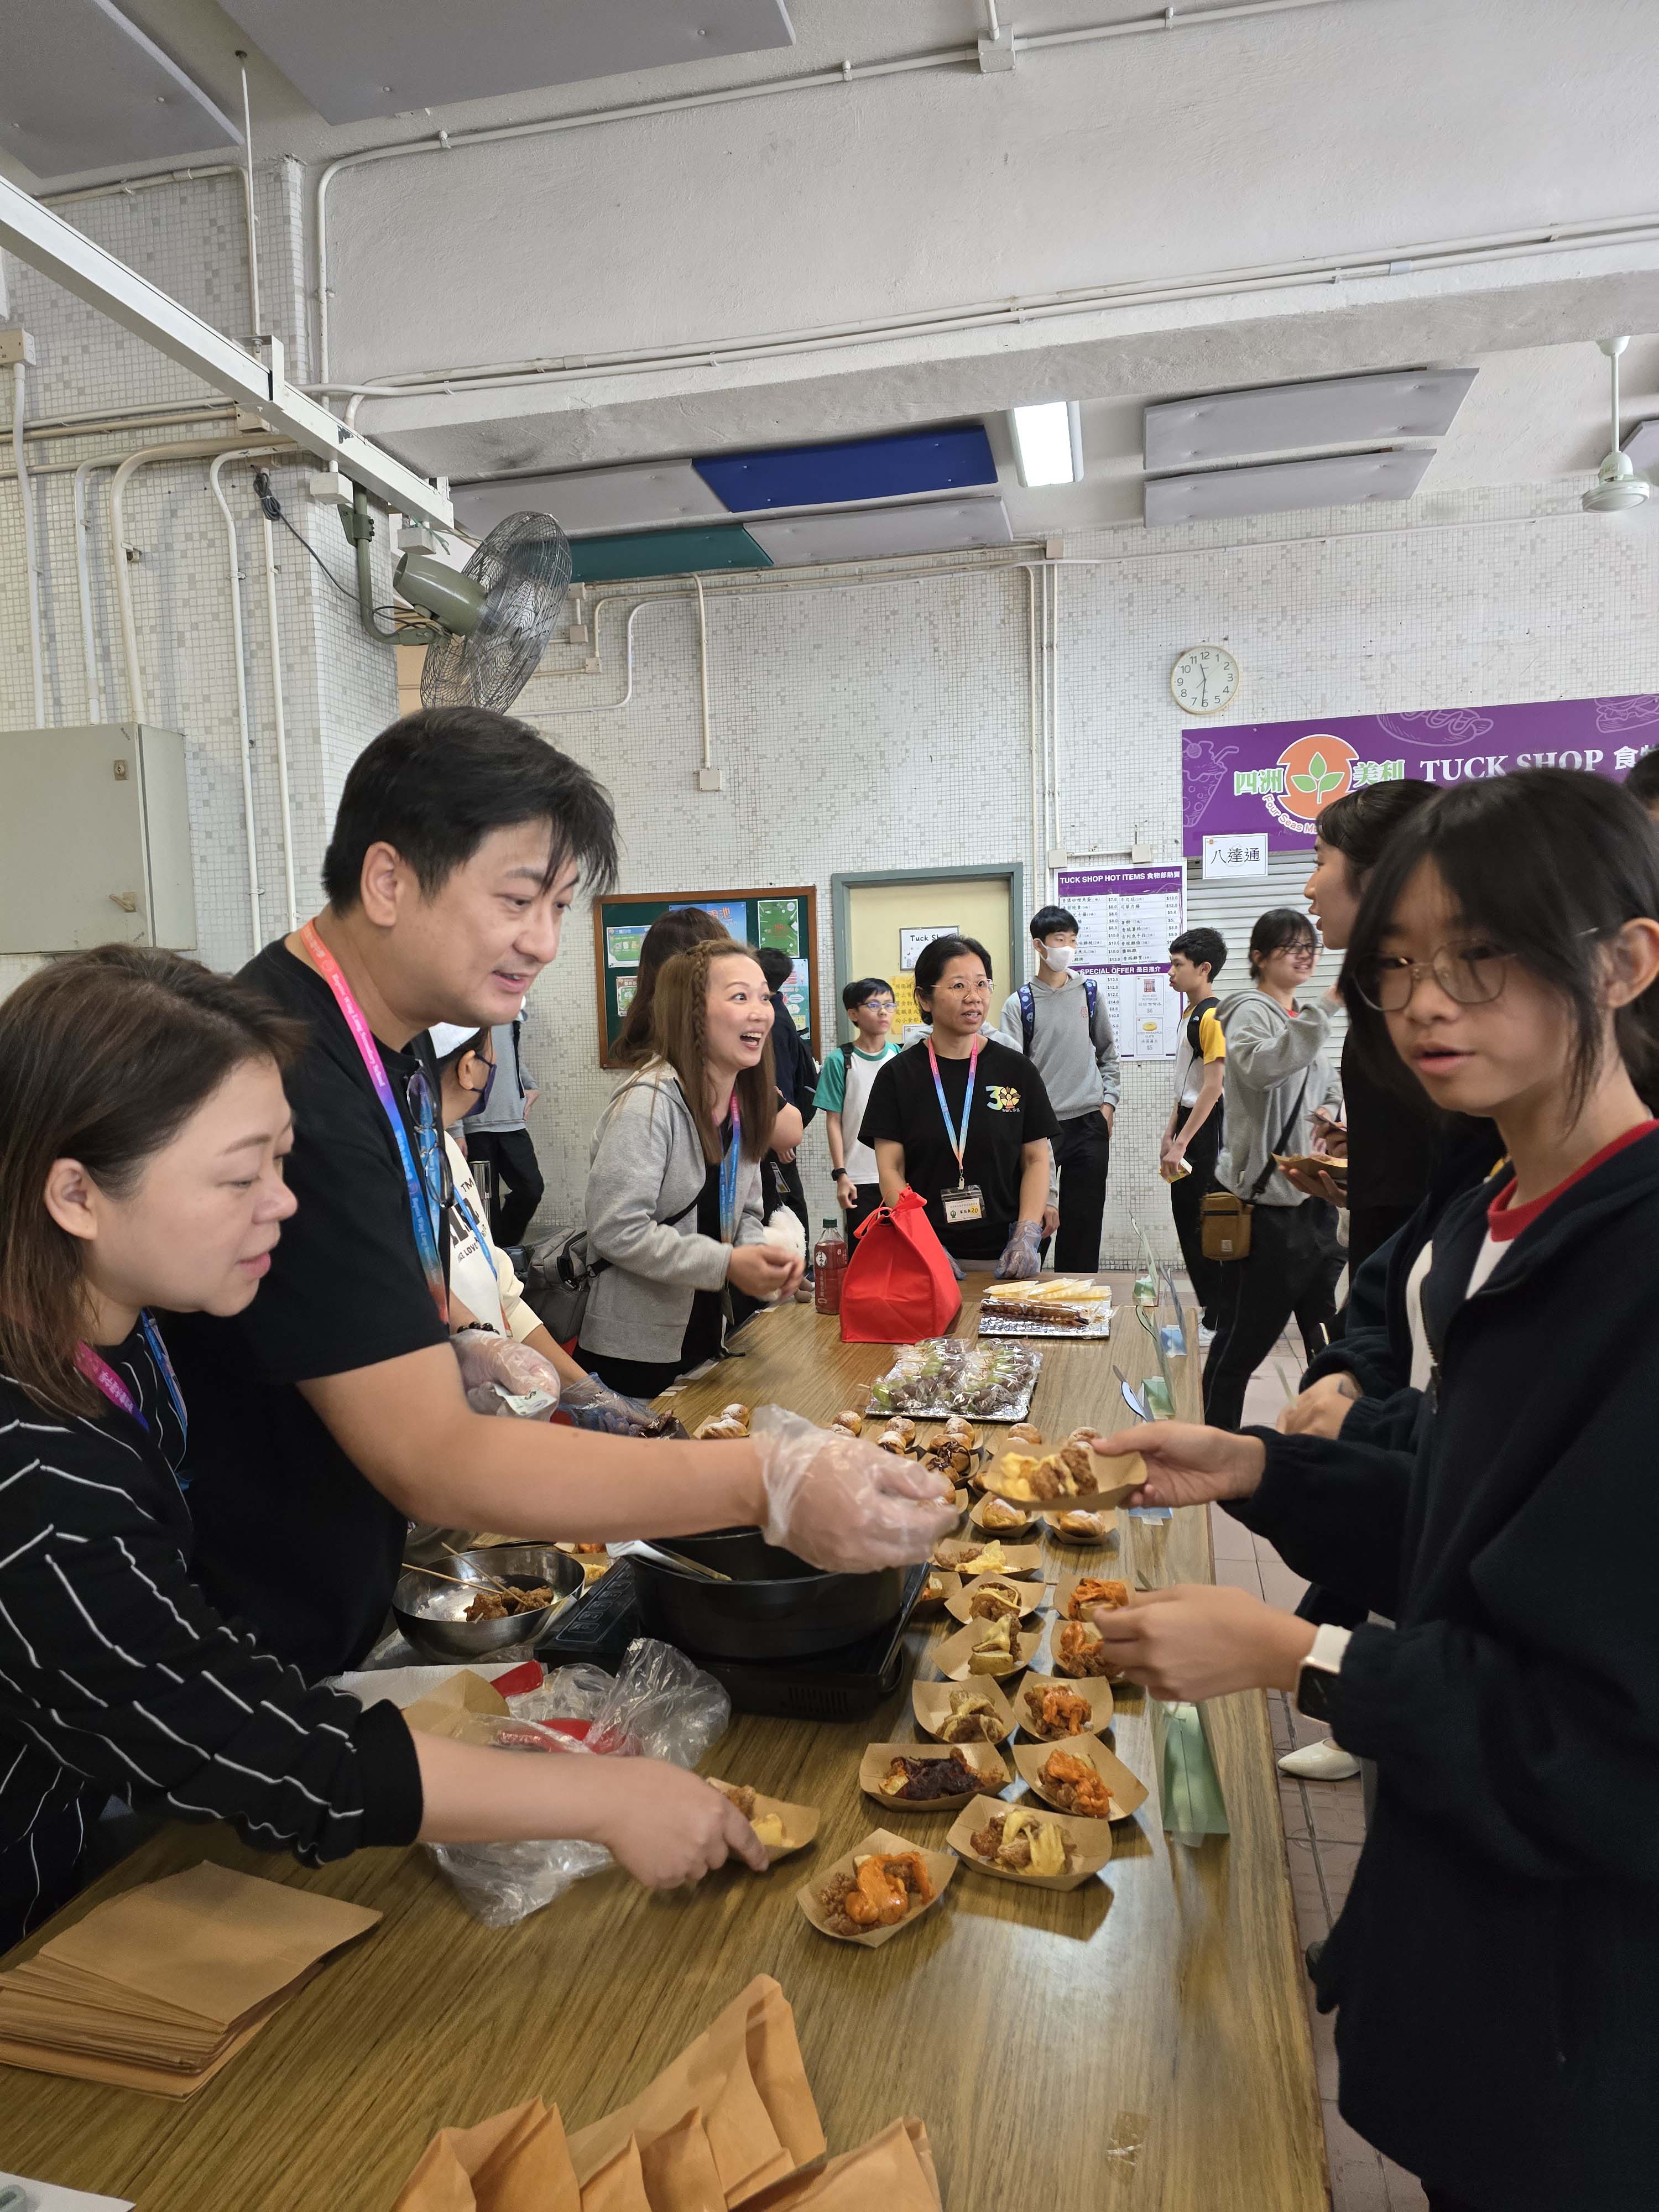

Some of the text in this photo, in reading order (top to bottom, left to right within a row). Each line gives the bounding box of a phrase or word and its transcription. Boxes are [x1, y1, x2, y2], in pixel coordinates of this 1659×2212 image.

[1200, 651, 1209, 660] 12
[1215, 654, 1219, 662] 1
[1181, 665, 1191, 674] 10
[1224, 662, 1230, 670] 2
[1177, 677, 1183, 686] 9
[1191, 697, 1197, 706] 7
[1234, 768, 1284, 795] 四洲
[1420, 755, 1509, 782] TUCK
[1516, 749, 1604, 771] SHOP
[1614, 745, 1655, 770] 食
[1263, 794, 1281, 817] Four
[1280, 813, 1303, 832] Seas
[1210, 847, 1260, 864] 八達通
[1082, 875, 1103, 883] SHOP
[1122, 873, 1145, 881] ITEMS
[344, 997, 354, 1015] Wing
[352, 1014, 363, 1033] Lung
[360, 1030, 375, 1066] Secondary
[373, 1065, 386, 1087] School
[461, 1178, 474, 1192] TM
[463, 1243, 478, 1258] LOVE
